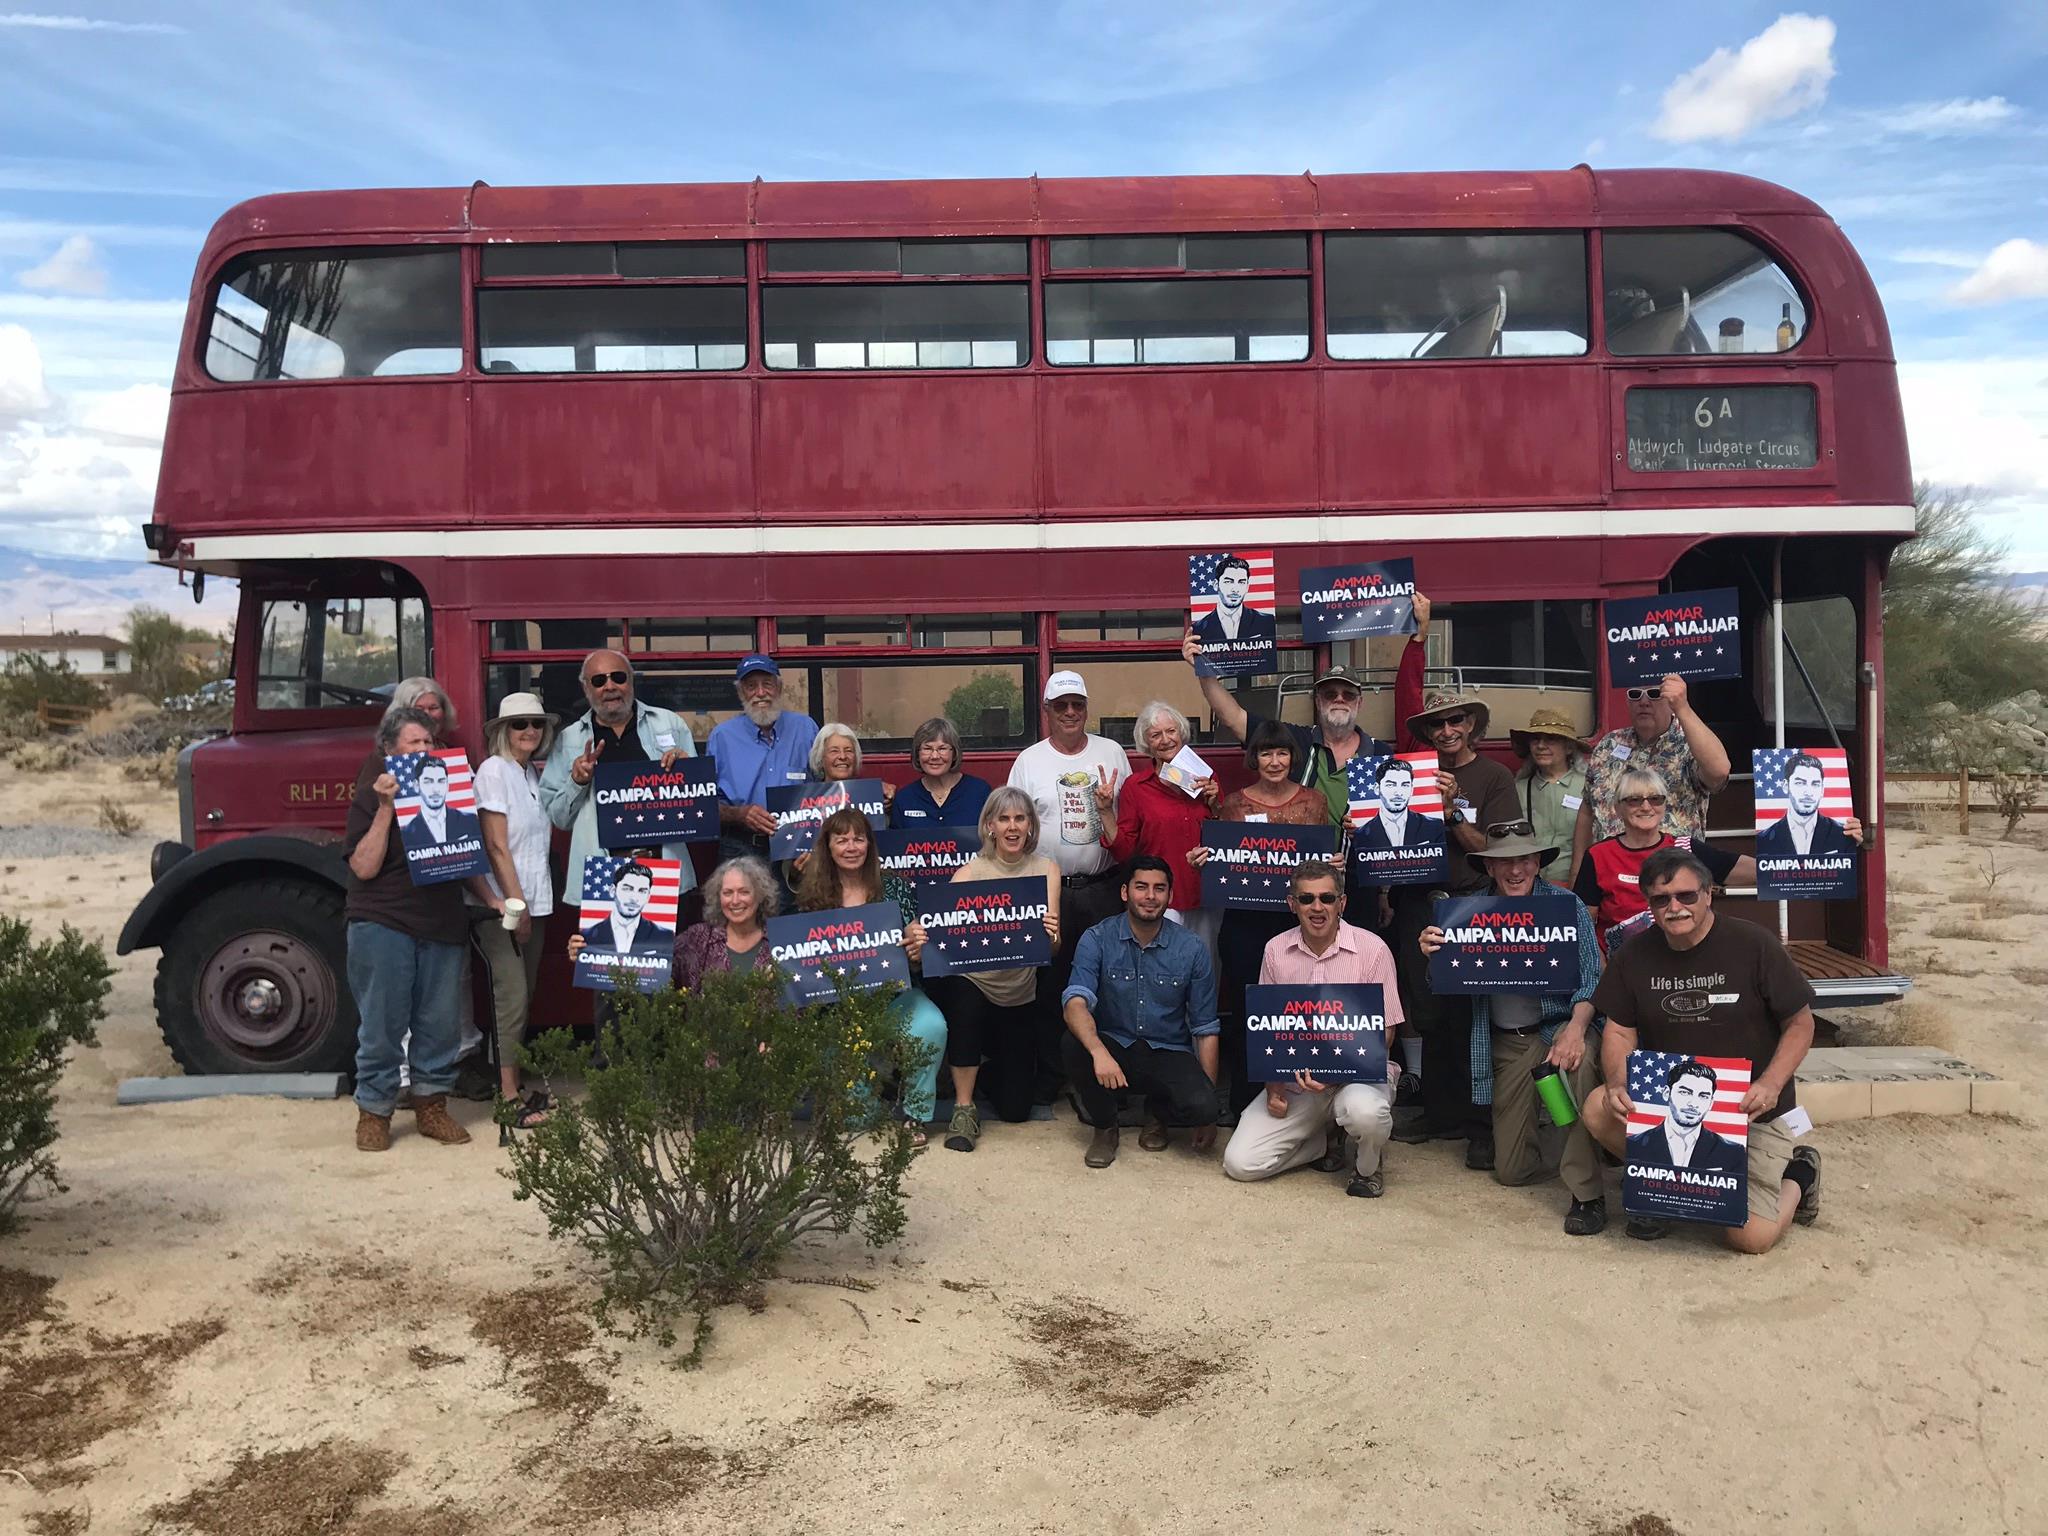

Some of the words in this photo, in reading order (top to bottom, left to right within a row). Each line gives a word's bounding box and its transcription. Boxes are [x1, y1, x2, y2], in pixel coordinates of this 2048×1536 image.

[1695, 398, 1713, 427] 6
[1720, 398, 1733, 418] A
[1628, 438, 1685, 457] Aldwych
[1698, 438, 1753, 458] Ludgate
[1760, 440, 1800, 456] Circus
[1333, 574, 1383, 589] AMMAR
[1302, 586, 1352, 605] CAMPA
[1356, 582, 1415, 601] NAJJAR
[1644, 606, 1704, 624] AMMAR
[1608, 624, 1670, 643] CAMPA
[1675, 616, 1739, 637] NAJJAR
[1233, 640, 1273, 651] NAJJAR
[1638, 641, 1657, 649] FOR
[1661, 635, 1714, 648] CONGRESS
[632, 772, 685, 788] AMMAR
[290, 784, 327, 801] RLH
[596, 787, 655, 804] CAMPA
[659, 782, 717, 800] NAJJAR
[624, 803, 643, 811] FOR
[646, 800, 695, 809] CONGRESS
[800, 793, 851, 809] AMMAR
[770, 808, 821, 825] CAMPA
[826, 802, 884, 819] NAR
[408, 846, 442, 861] CAMPA
[444, 840, 481, 855] NAJJAR
[906, 841, 957, 854] AMMAR
[1239, 836, 1297, 852] AMMAR
[931, 852, 978, 867] NAJJA
[1206, 848, 1262, 865] CAMPA
[1358, 851, 1396, 862] CAMPA
[1400, 848, 1443, 859] NAJJAR
[918, 868, 958, 876] CONGRE
[1230, 864, 1249, 872] FOR
[1252, 866, 1293, 876] CONGRE
[1759, 860, 1800, 871] CAMPA
[1804, 858, 1851, 870] NAJJAR
[956, 894, 1013, 910] AMMAR
[920, 910, 979, 929] CAMPA
[984, 904, 1048, 923] NAJJAR
[1470, 912, 1534, 927] AMMAR
[808, 921, 865, 941] AMMAR
[948, 928, 967, 936] FOR
[970, 922, 1022, 934] CONGRESS
[1444, 928, 1497, 943] AMPA
[1502, 926, 1577, 943] NAJJAR
[771, 940, 833, 962] CAMPA
[836, 929, 903, 953] NAJJAR
[1486, 944, 1546, 953] CONGRESS
[579, 953, 620, 966] CAMPA
[622, 956, 668, 969] NAJJAR
[802, 956, 821, 967] FOR
[825, 950, 878, 963] CONGRESS
[1651, 977, 1672, 990] Life
[1674, 977, 1685, 990] is
[1686, 972, 1725, 989] simple
[1284, 1000, 1344, 1015] AMMAR
[1247, 1015, 1307, 1031] CAMPA
[1312, 1015, 1384, 1031] NAJJAR
[1275, 1032, 1295, 1041] FOR
[1299, 1032, 1354, 1041] CONGRESS
[1627, 1164, 1677, 1182] CAMPA
[1680, 1172, 1738, 1190] NAJJAR
[1643, 1180, 1662, 1189] FOR
[1665, 1182, 1721, 1197] CONGRESS
